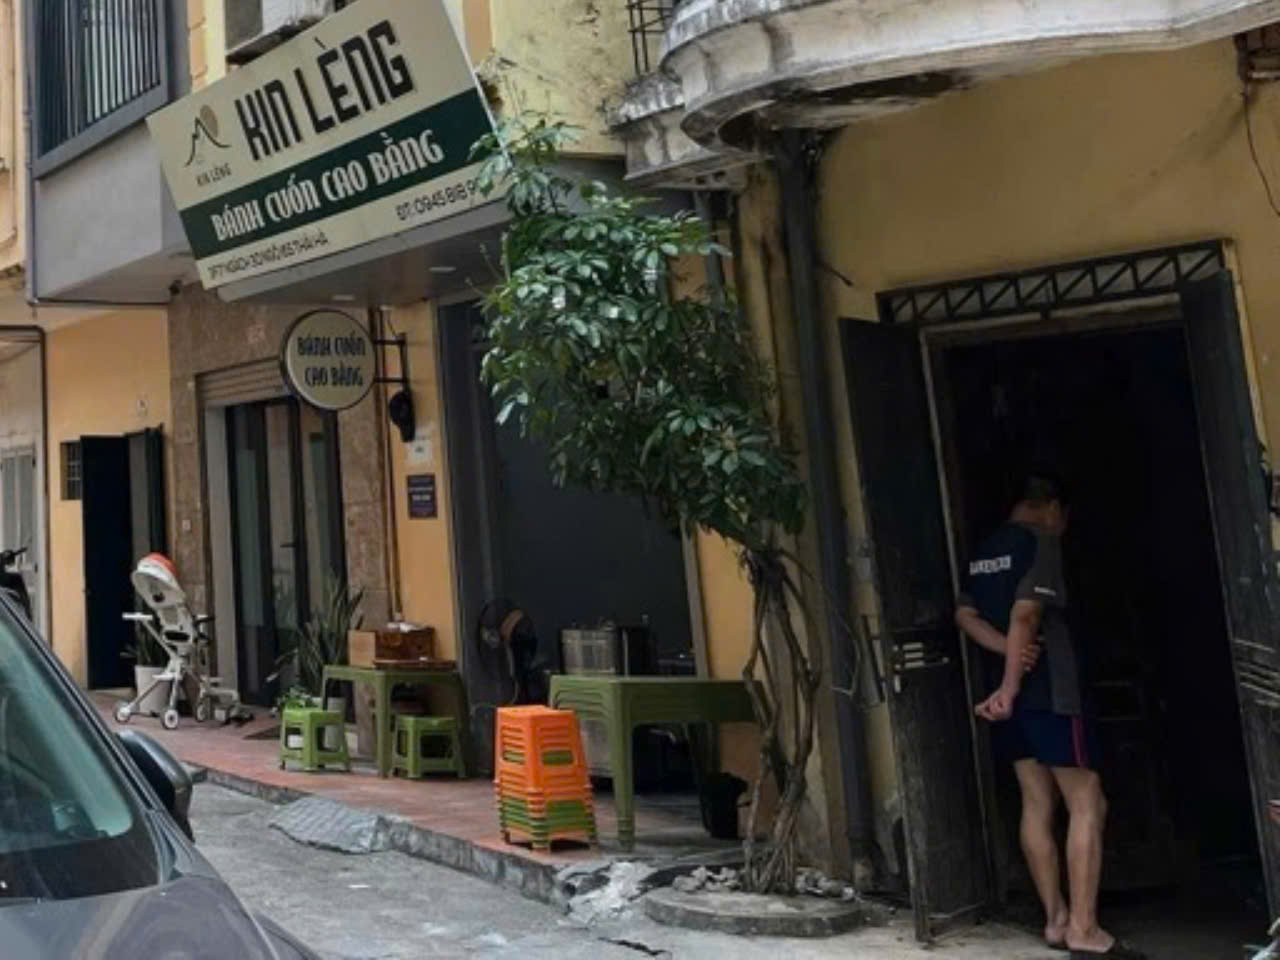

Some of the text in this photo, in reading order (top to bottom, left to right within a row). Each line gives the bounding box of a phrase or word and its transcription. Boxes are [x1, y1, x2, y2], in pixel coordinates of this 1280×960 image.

[210, 129, 444, 240] BÁNH CUỐN CAO BẰNG
